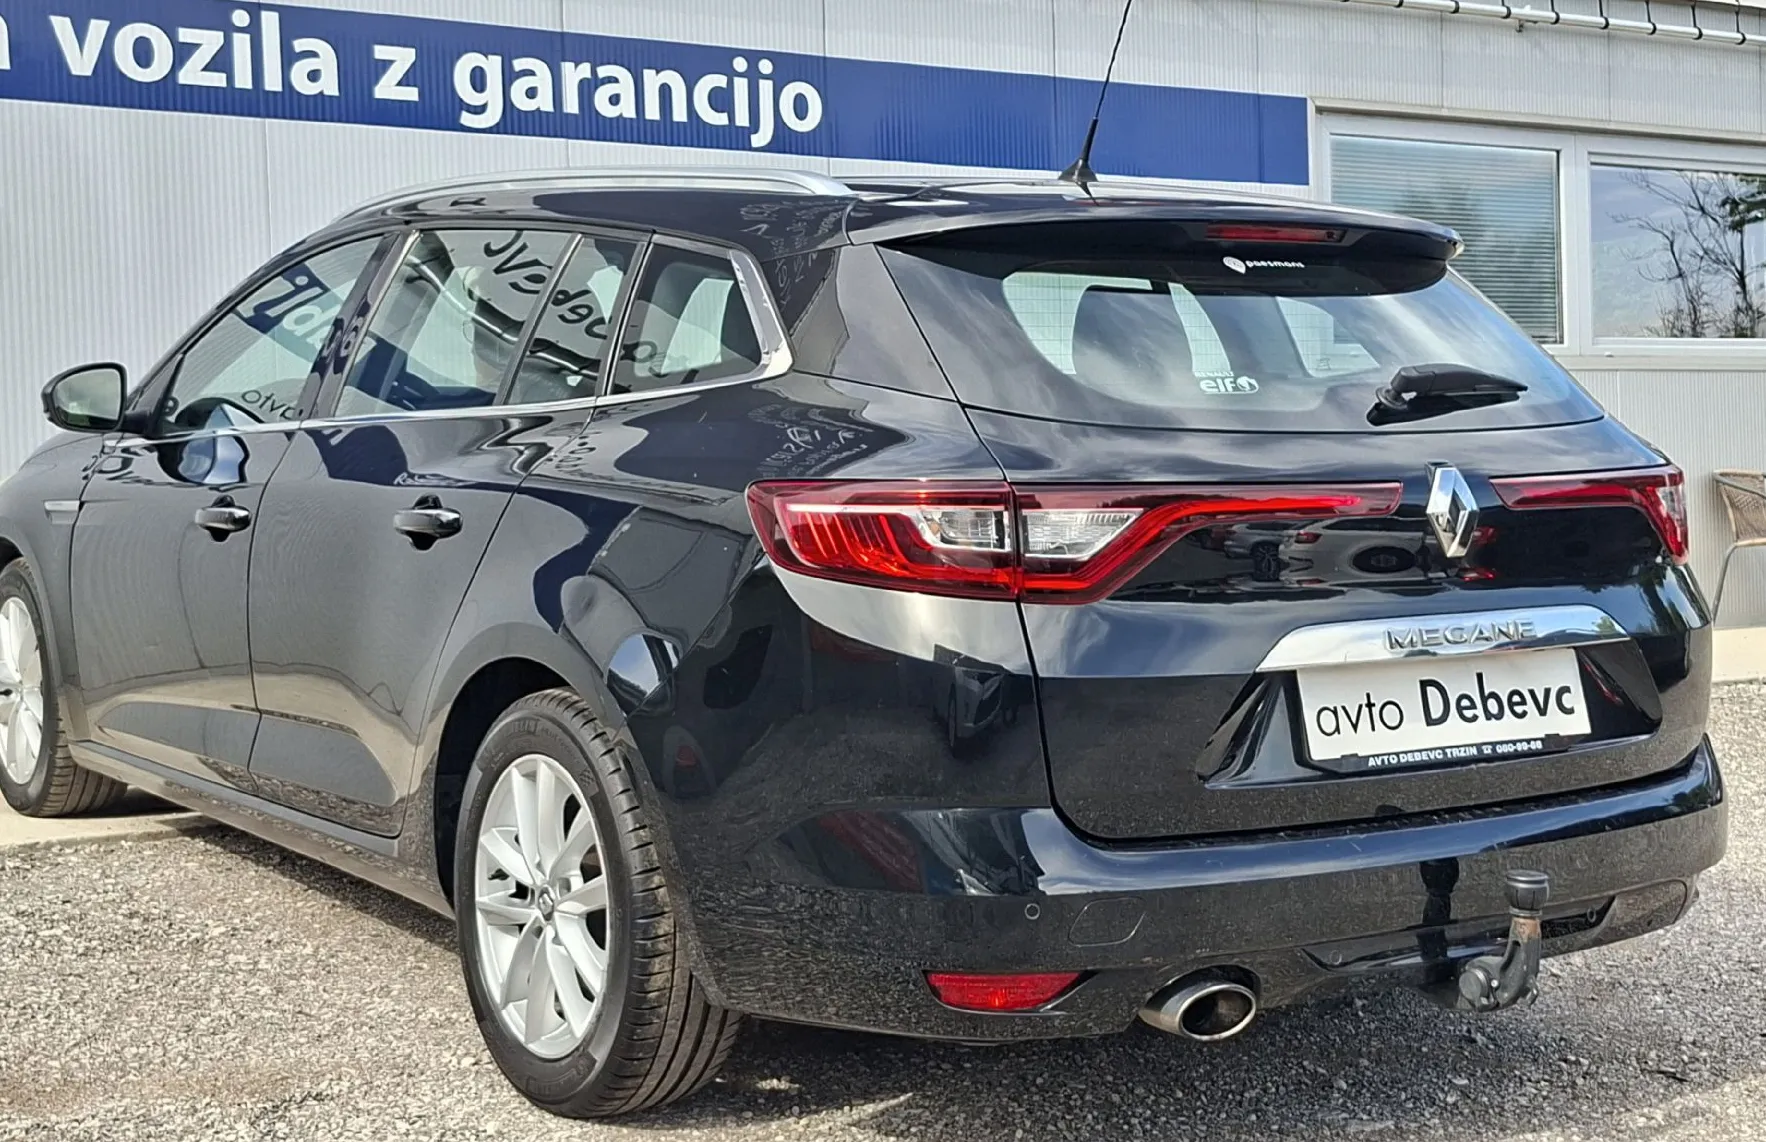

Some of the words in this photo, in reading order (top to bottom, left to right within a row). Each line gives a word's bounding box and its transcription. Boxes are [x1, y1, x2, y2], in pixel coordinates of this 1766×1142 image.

[50, 9, 339, 97] vozila
[373, 44, 420, 102] z
[453, 52, 822, 148] garancijo
[1199, 377, 1235, 392] elf
[1386, 618, 1538, 650] MEGANE
[1316, 693, 1404, 737] avto
[1419, 671, 1575, 727] Debevc
[1368, 755, 1398, 768] AVTO
[1400, 750, 1443, 764] DEBEVC
[1445, 745, 1477, 759] TRZIN
